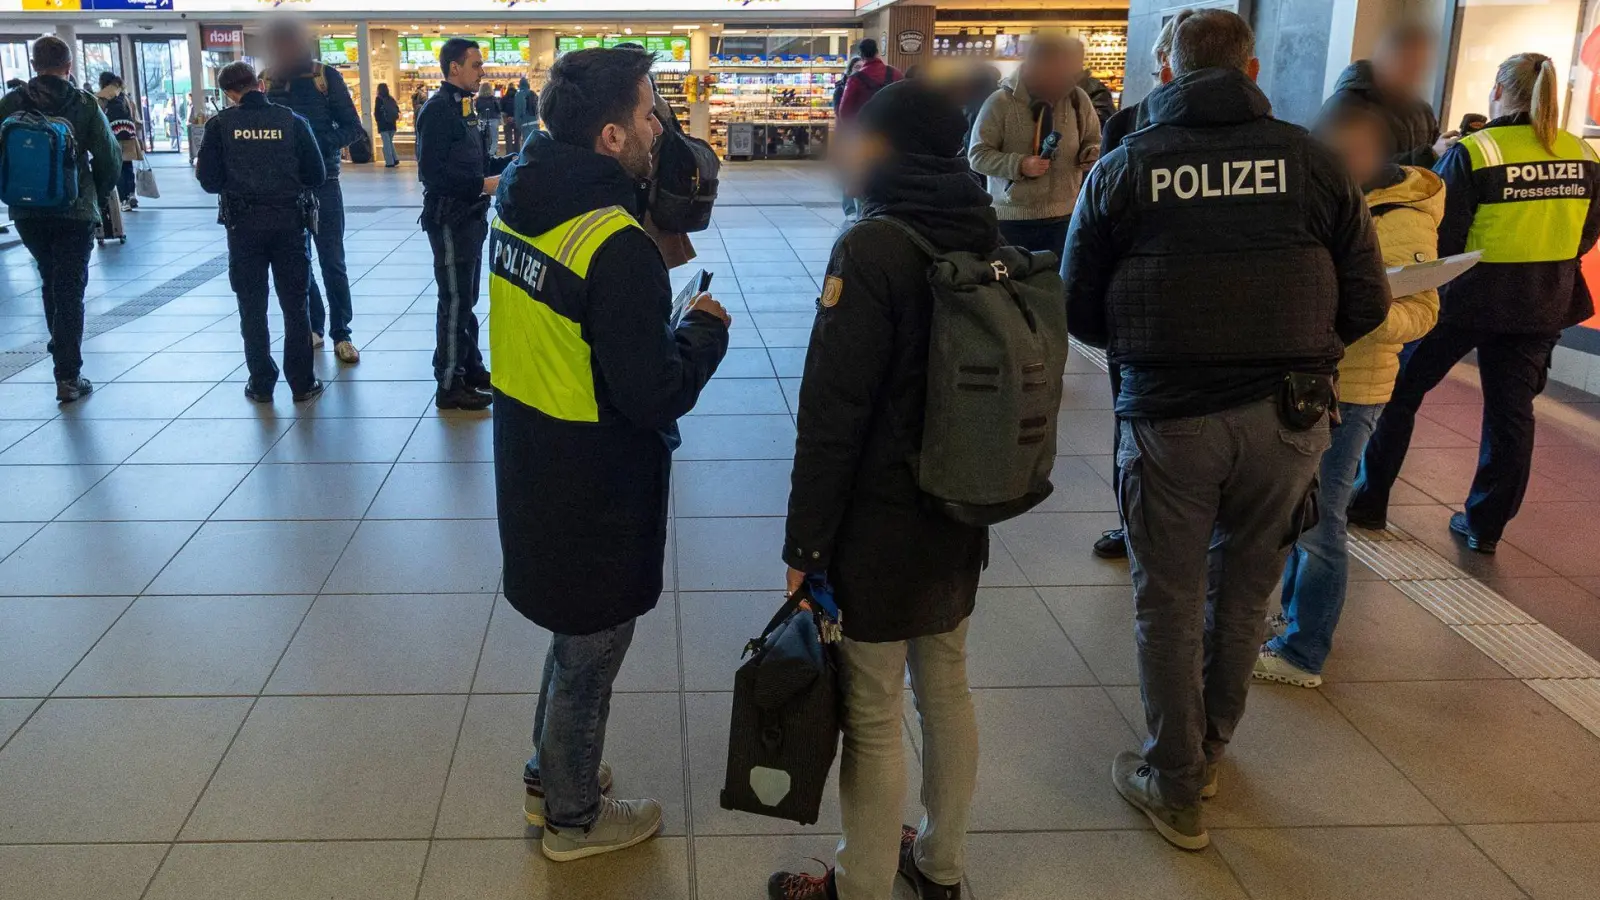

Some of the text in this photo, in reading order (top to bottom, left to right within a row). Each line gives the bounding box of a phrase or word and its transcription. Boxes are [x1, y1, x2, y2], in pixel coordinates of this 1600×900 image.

[234, 129, 282, 139] POLIZEI
[1151, 159, 1287, 202] POLIZEI
[1506, 163, 1584, 183] POLIZEI
[1503, 184, 1586, 200] Pressestelle
[494, 240, 547, 292] POLIZEI
